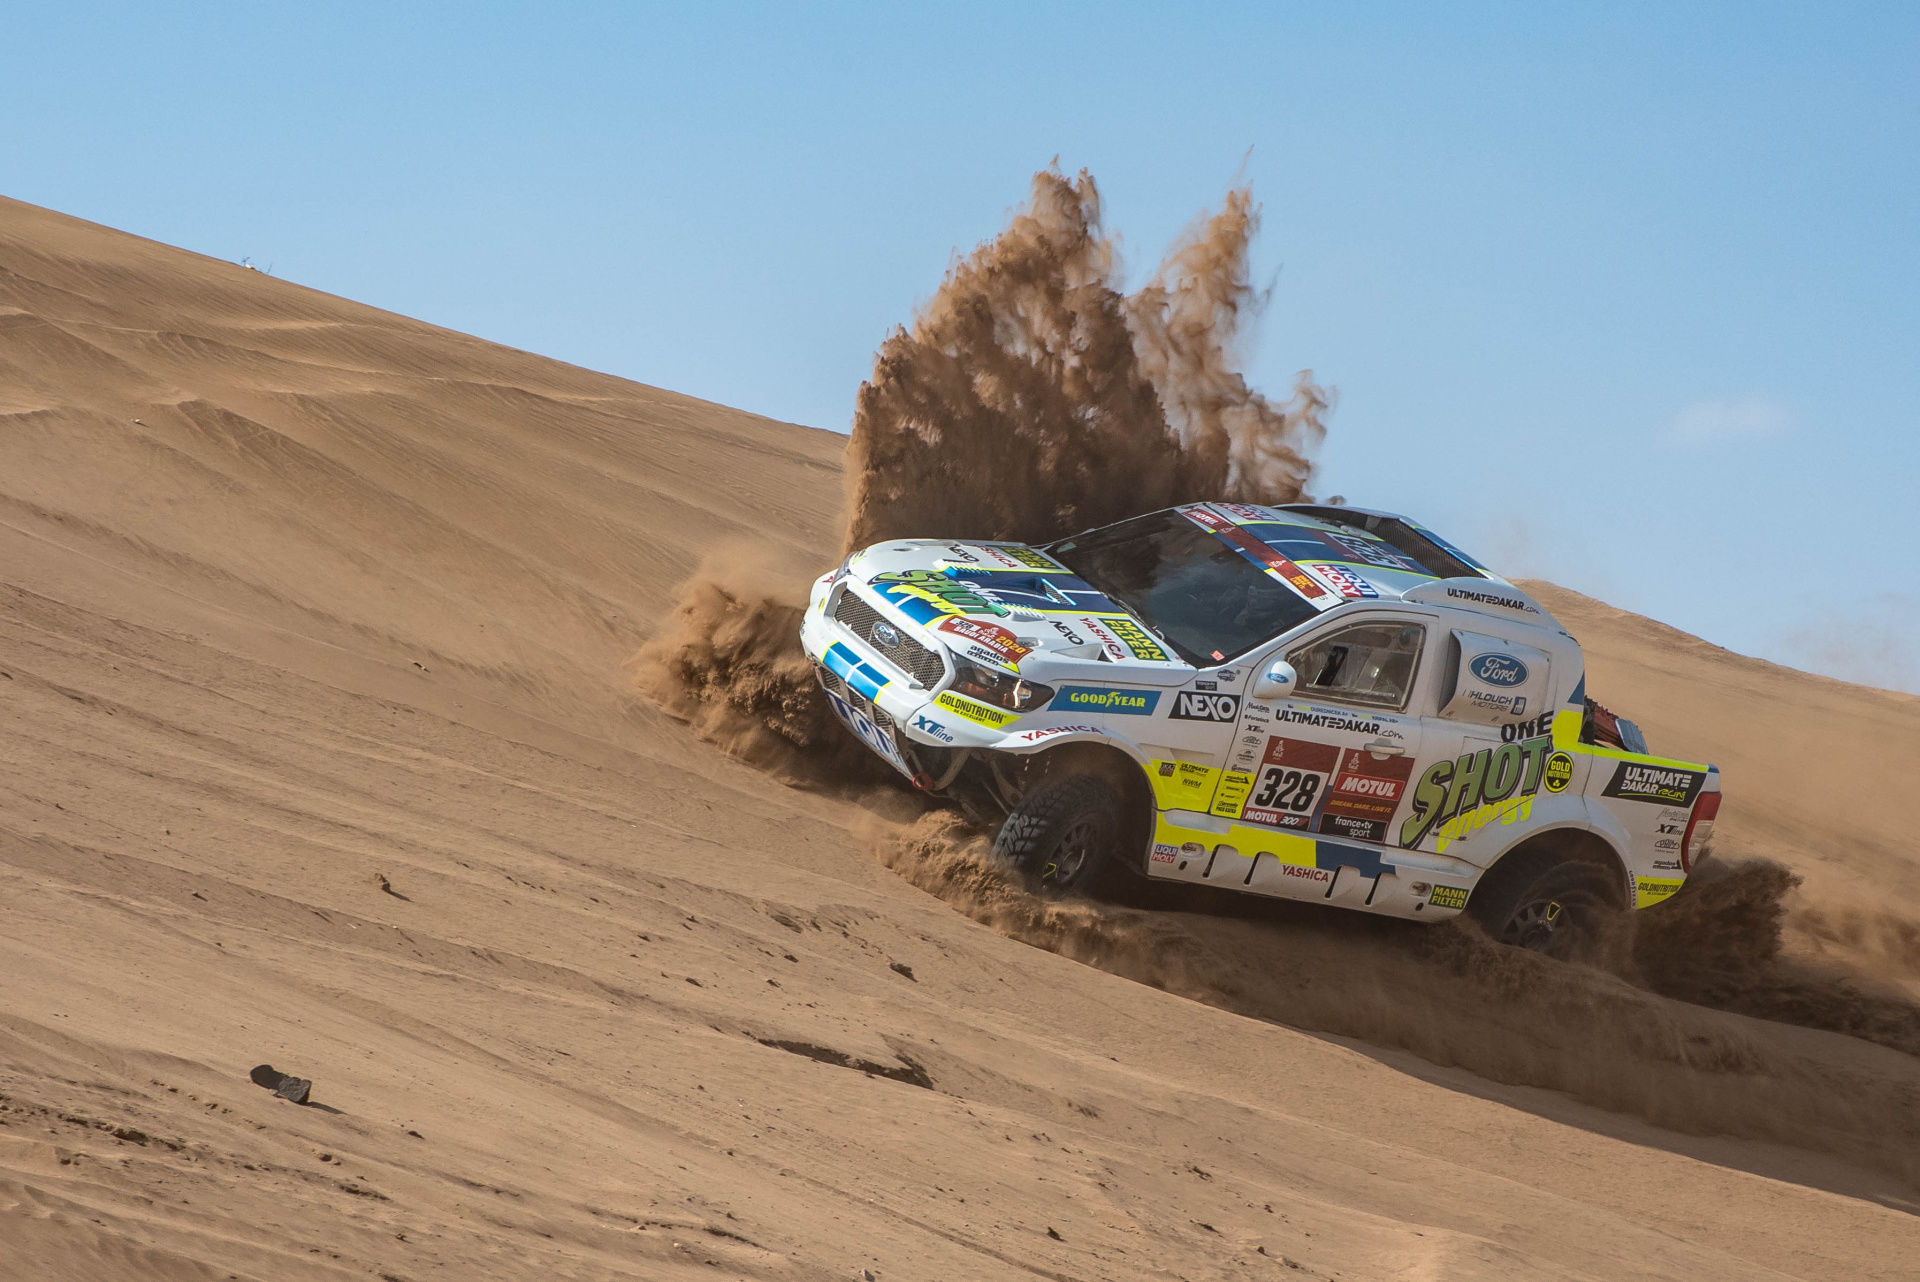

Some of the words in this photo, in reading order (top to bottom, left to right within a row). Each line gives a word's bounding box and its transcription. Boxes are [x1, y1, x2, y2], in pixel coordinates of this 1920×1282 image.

[1315, 564, 1361, 596] MOLY
[1333, 564, 1378, 596] LIQUI
[953, 626, 979, 641] SAUDI
[977, 634, 1007, 654] ARABIA
[1049, 620, 1085, 646] NEXO
[1080, 617, 1126, 660] YASHICA
[1104, 620, 1151, 660] FILTER
[1119, 620, 1165, 660] MANN
[969, 644, 1009, 665] agados
[996, 636, 1026, 655] 2020
[1479, 656, 1520, 683] Ford
[939, 693, 1004, 725] GOLDNUTRITION
[1070, 691, 1147, 709] GOODYEAR
[1180, 692, 1236, 721] NEXO
[912, 715, 954, 744] XTline
[1021, 725, 1105, 743] YASHICA
[1500, 710, 1554, 743] ONE
[1550, 760, 1571, 772] GOLD
[1341, 777, 1397, 798] MOTUL
[1625, 766, 1693, 789] ULTIMATE
[1254, 767, 1321, 813] 328
[1400, 734, 1554, 851] SHOT
[1620, 780, 1659, 795] DAKAR
[1658, 786, 1687, 800] racing
[1245, 809, 1278, 824] MOTUL
[1349, 828, 1370, 839] sport
[1656, 823, 1685, 837] XTline
[1152, 853, 1176, 864] MOLY
[1156, 844, 1179, 855] LIQUI
[1280, 864, 1330, 883] YASHICA
[1430, 895, 1465, 909] FILTER
[1433, 886, 1467, 900] MANN
